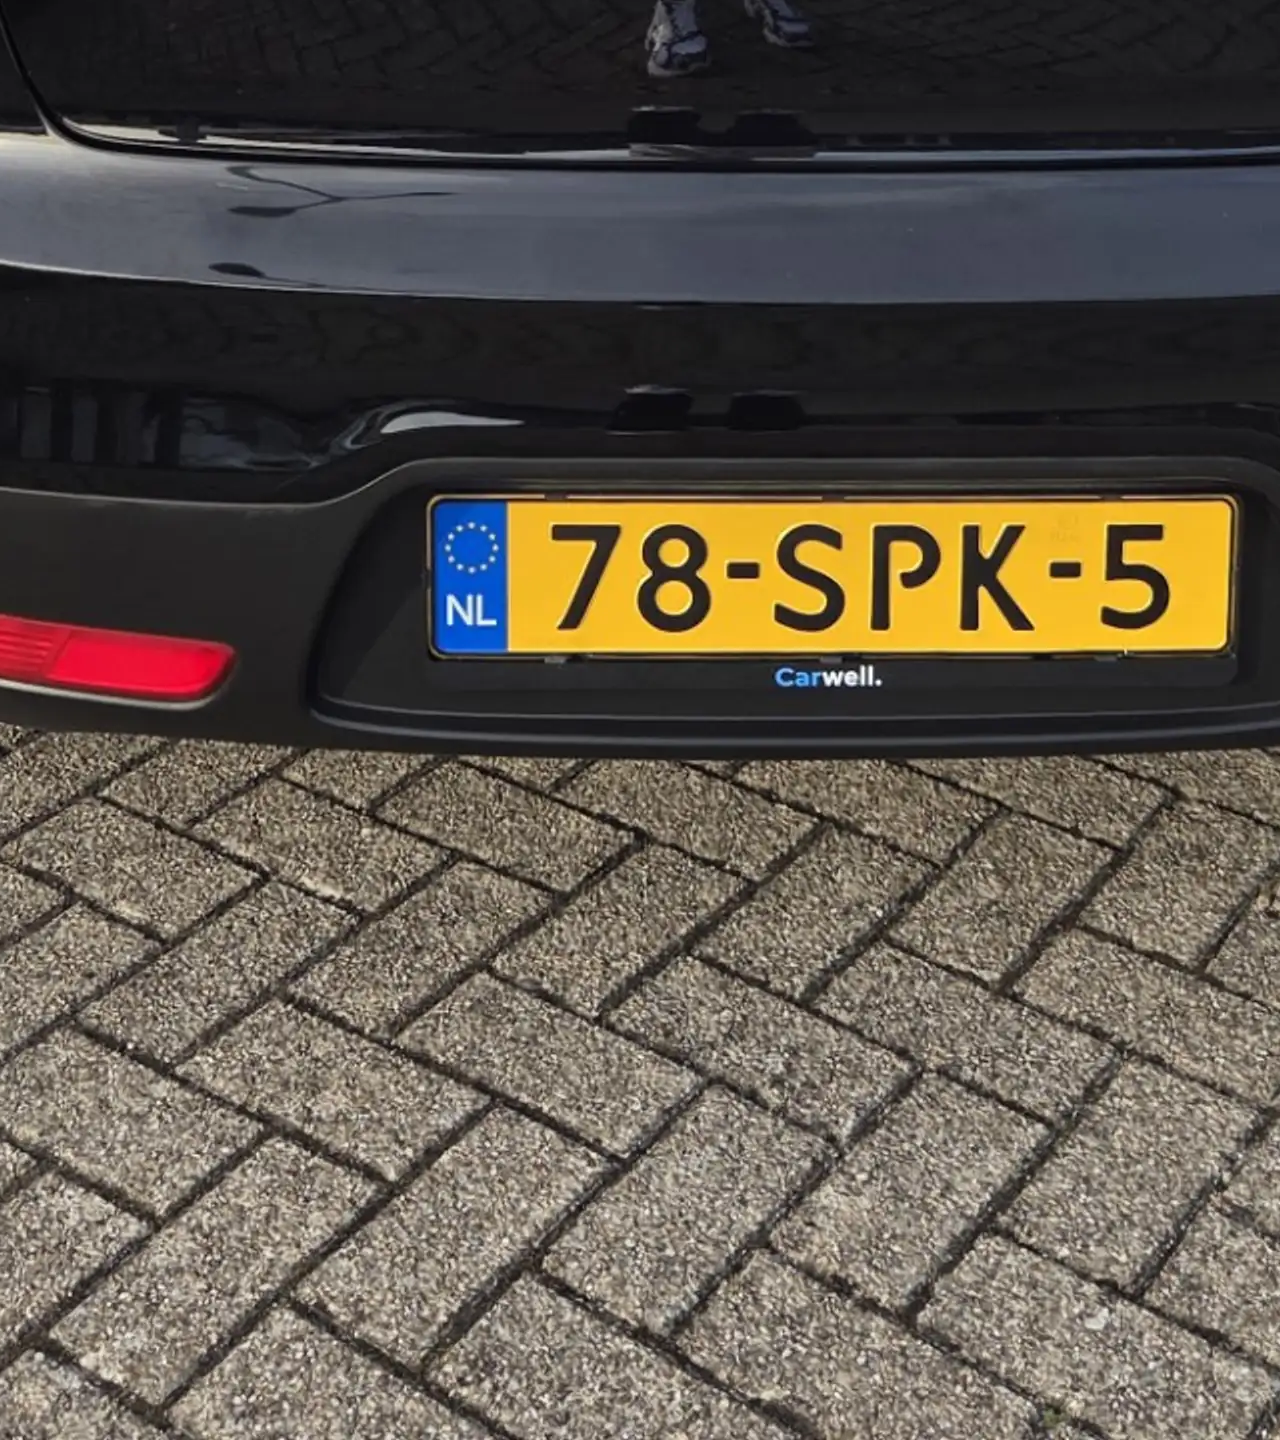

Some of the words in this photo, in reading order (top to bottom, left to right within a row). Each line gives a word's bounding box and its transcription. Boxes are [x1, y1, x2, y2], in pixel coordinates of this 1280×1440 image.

[445, 594, 497, 627] NL
[548, 522, 1171, 633] 78-SPK-5
[774, 663, 883, 688] Carwell.
